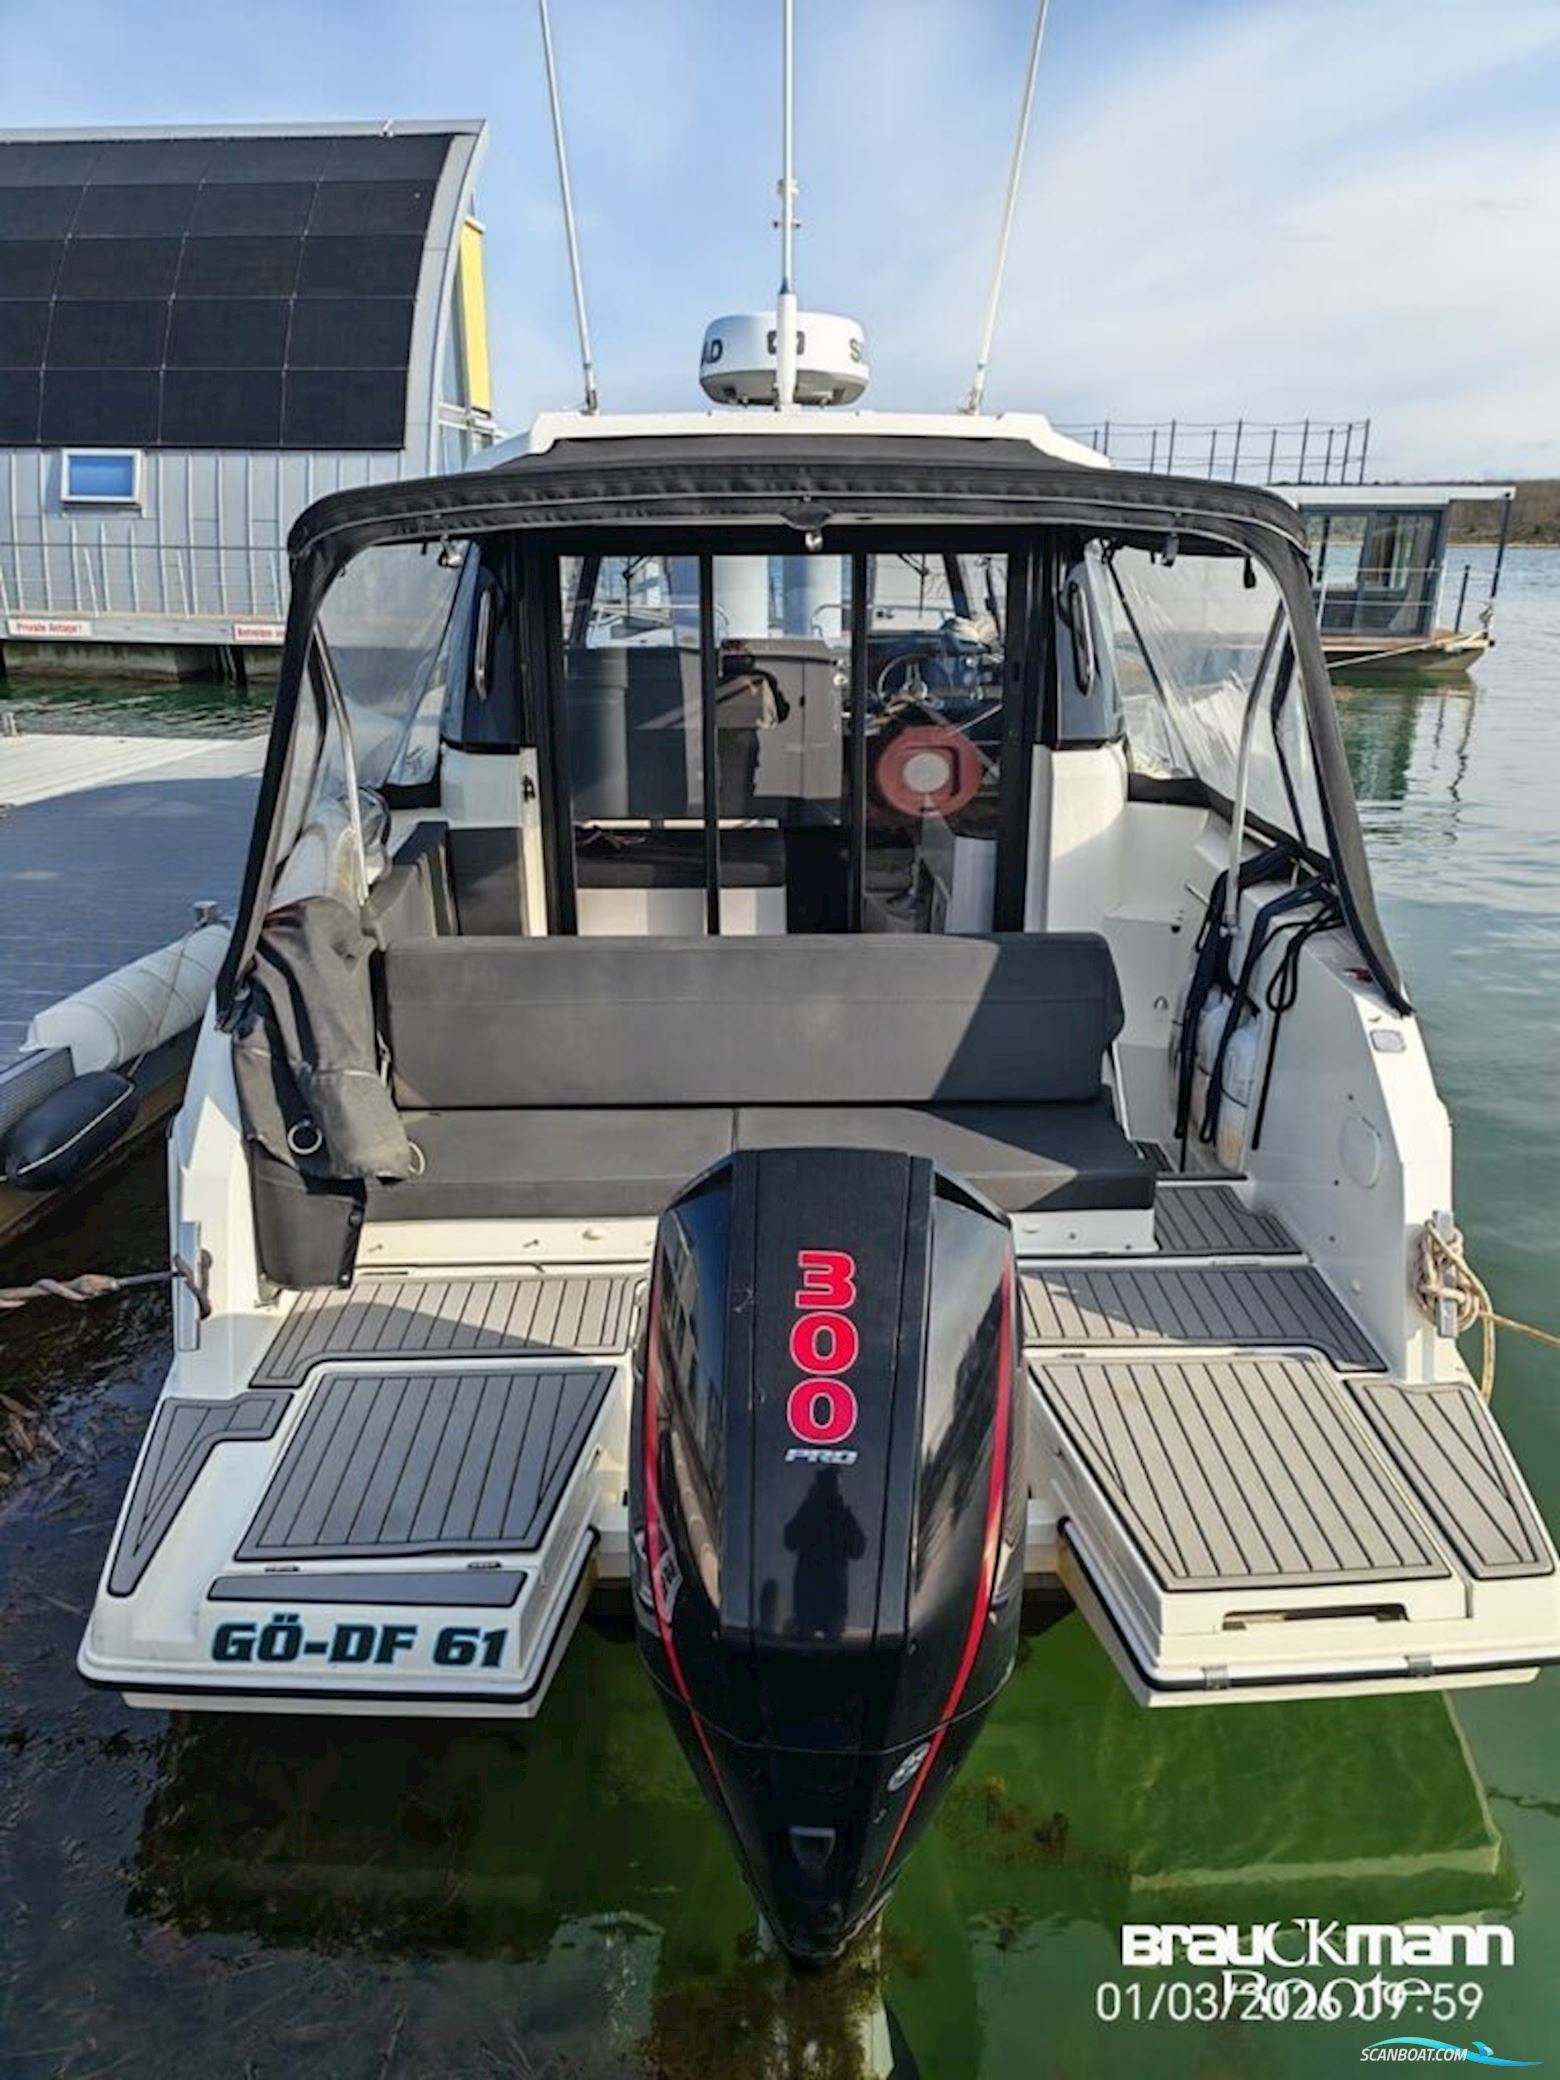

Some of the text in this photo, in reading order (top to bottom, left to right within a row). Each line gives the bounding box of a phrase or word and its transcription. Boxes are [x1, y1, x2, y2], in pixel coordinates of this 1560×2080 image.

[786, 1250, 860, 1445] 300
[784, 1448, 859, 1465] PRO
[211, 1613, 508, 1668] GÖ-DF 61
